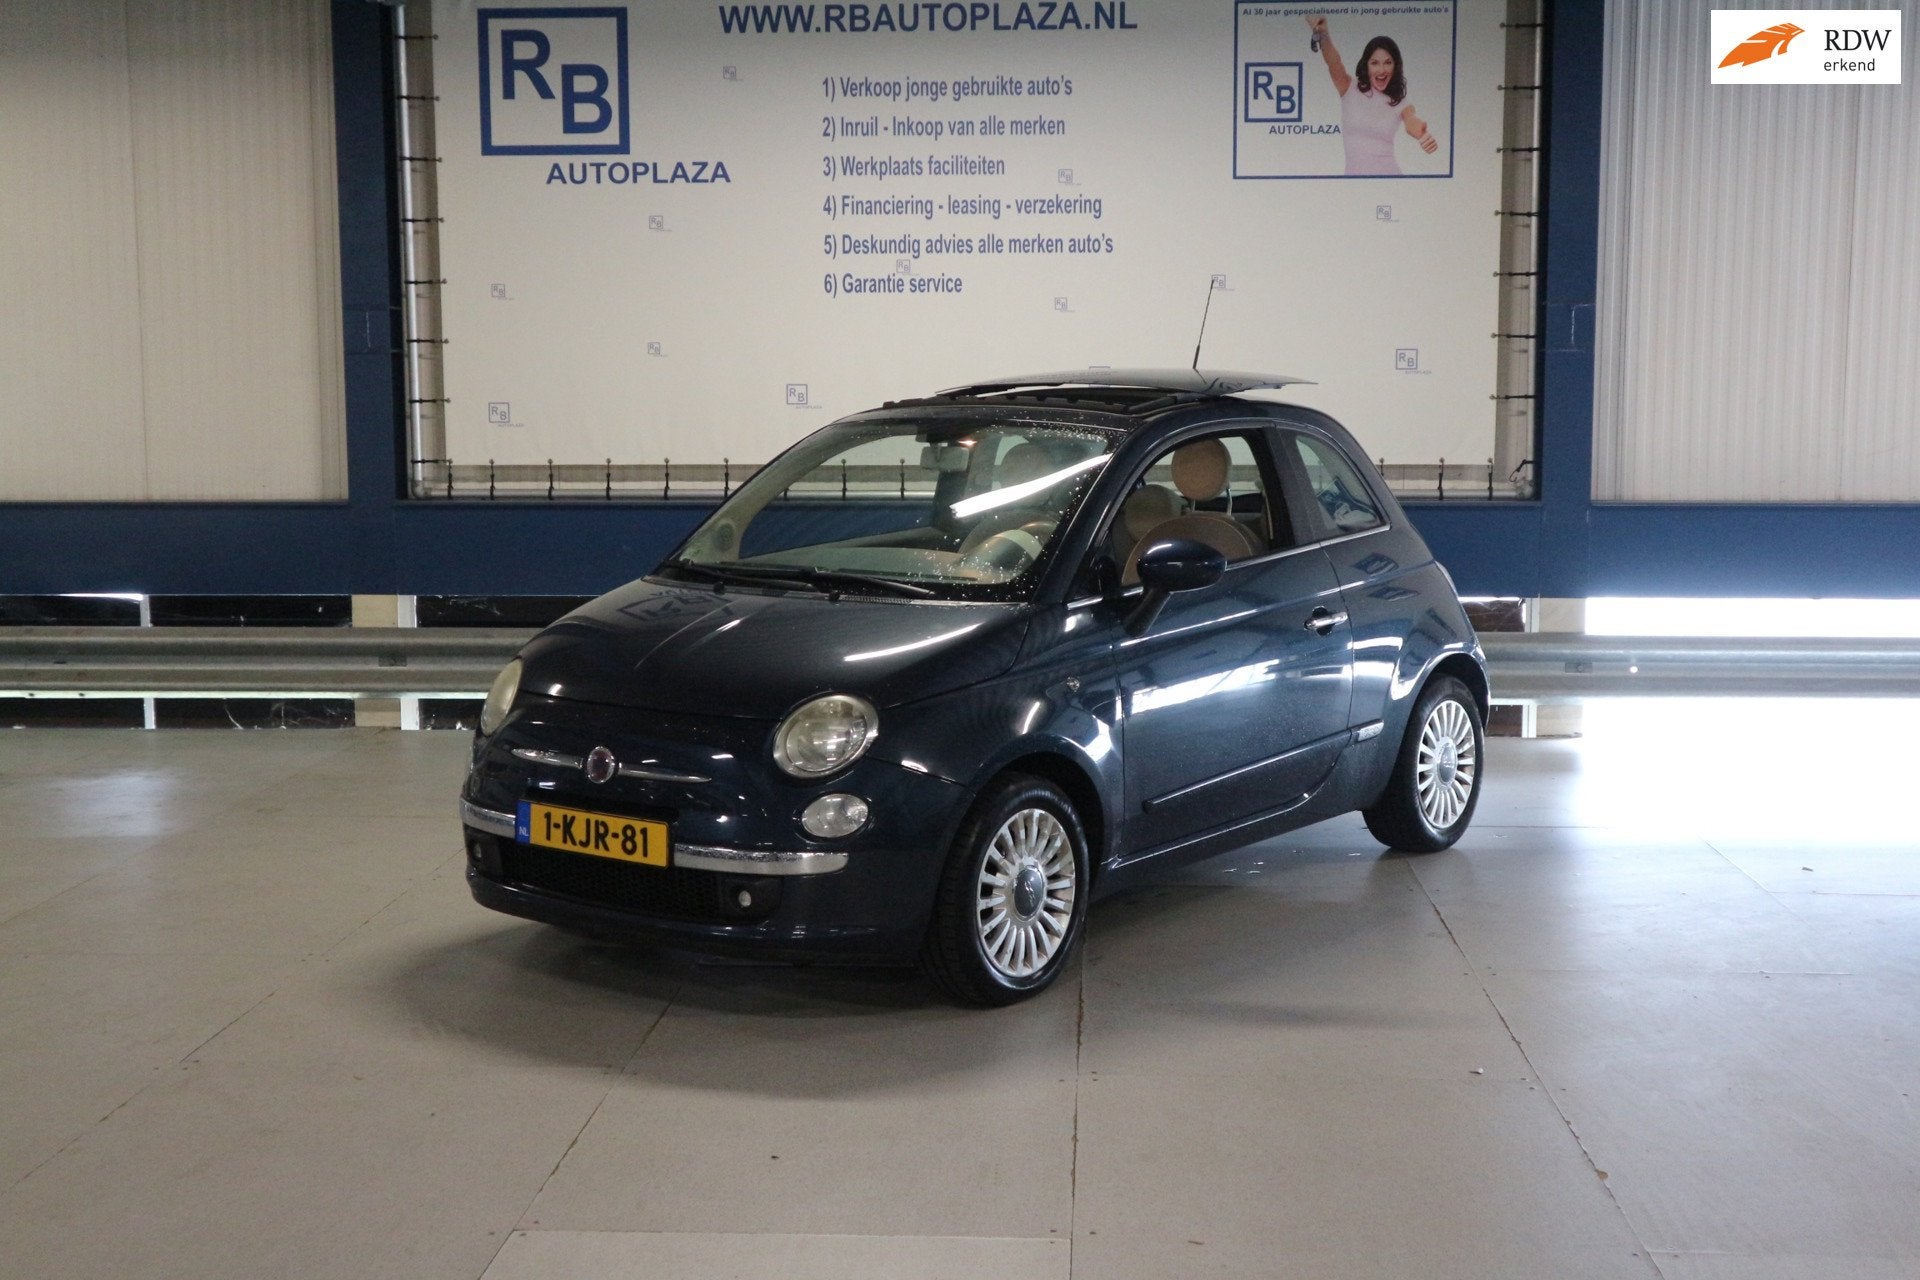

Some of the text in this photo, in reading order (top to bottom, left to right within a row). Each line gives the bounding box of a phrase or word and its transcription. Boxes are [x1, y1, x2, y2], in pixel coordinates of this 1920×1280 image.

[719, 1, 1138, 34] WWW.RBAUTOPLAZA.NL
[1266, 8, 1281, 17] jaar
[1284, 7, 1349, 17] gespecialiseerd
[1351, 6, 1359, 14] in
[1361, 6, 1380, 16] jong
[1382, 6, 1422, 16] gebruikte
[1424, 5, 1449, 14] auto's
[823, 74, 1073, 103] 1) Verkoop jonge gebruikte auto's
[823, 116, 836, 142] 2)
[841, 116, 878, 137] Inruil
[893, 115, 943, 141] Inkoop
[948, 120, 975, 136] van
[980, 115, 1006, 136] alle
[1010, 115, 1066, 136] merken
[1269, 124, 1341, 135] AUTOPLAZA
[546, 161, 732, 185] AUTOPLAZA
[823, 154, 1005, 182] 3) Werkplaats faciliteiten
[823, 195, 837, 221] 4)
[841, 194, 934, 221] Financiering
[947, 194, 1001, 220] leasing
[1015, 193, 1102, 220] verzekering
[824, 232, 1114, 261] 5) Deskundig advies alle merken auto's
[824, 272, 963, 299] 6) Garantie service
[518, 825, 529, 836] NL
[544, 811, 648, 858] 1-KJR-81
